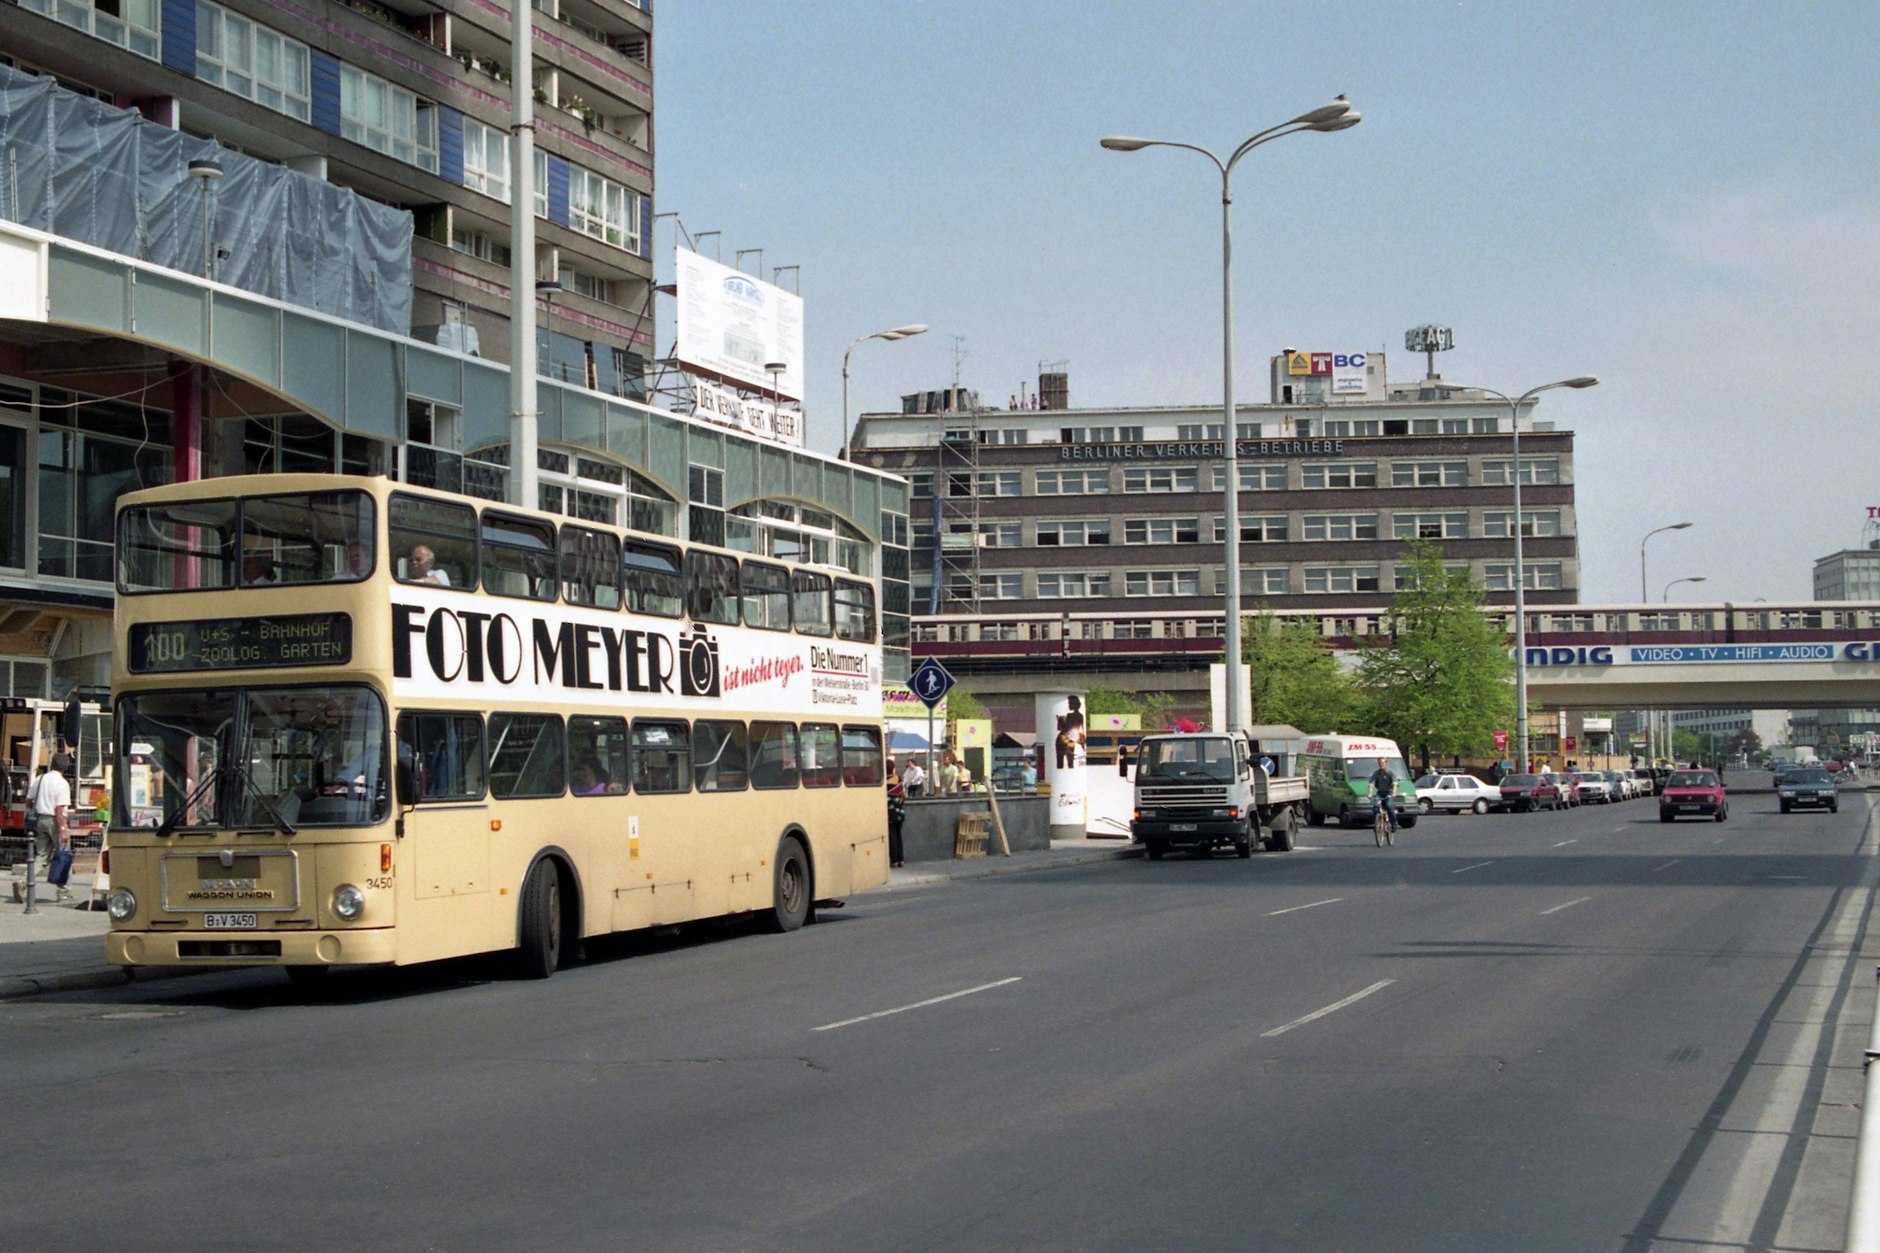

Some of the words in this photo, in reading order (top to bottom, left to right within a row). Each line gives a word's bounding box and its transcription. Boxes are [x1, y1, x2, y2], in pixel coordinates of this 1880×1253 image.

[1062, 446, 1144, 458] BERLINER
[1156, 440, 1343, 456] VERKEHS-BETRIEBE
[260, 621, 329, 640] BAHNHOF
[201, 645, 266, 662] ZOOLOG.
[280, 642, 342, 658] GARTEN
[391, 603, 522, 685] FOTO
[532, 618, 674, 694] MEYER
[1637, 648, 1683, 661] VIDEO
[1700, 648, 1717, 660] TV
[1735, 647, 1762, 659] HIFI
[1779, 645, 1828, 659] AUDIO
[810, 646, 826, 669] Die
[828, 648, 863, 673] Nummer
[723, 665, 739, 692] ist
[741, 656, 772, 687] nicht
[366, 878, 393, 889] 3450
[187, 891, 234, 899] WAGGON
[237, 890, 272, 898] UNION
[231, 914, 255, 926] 3450
